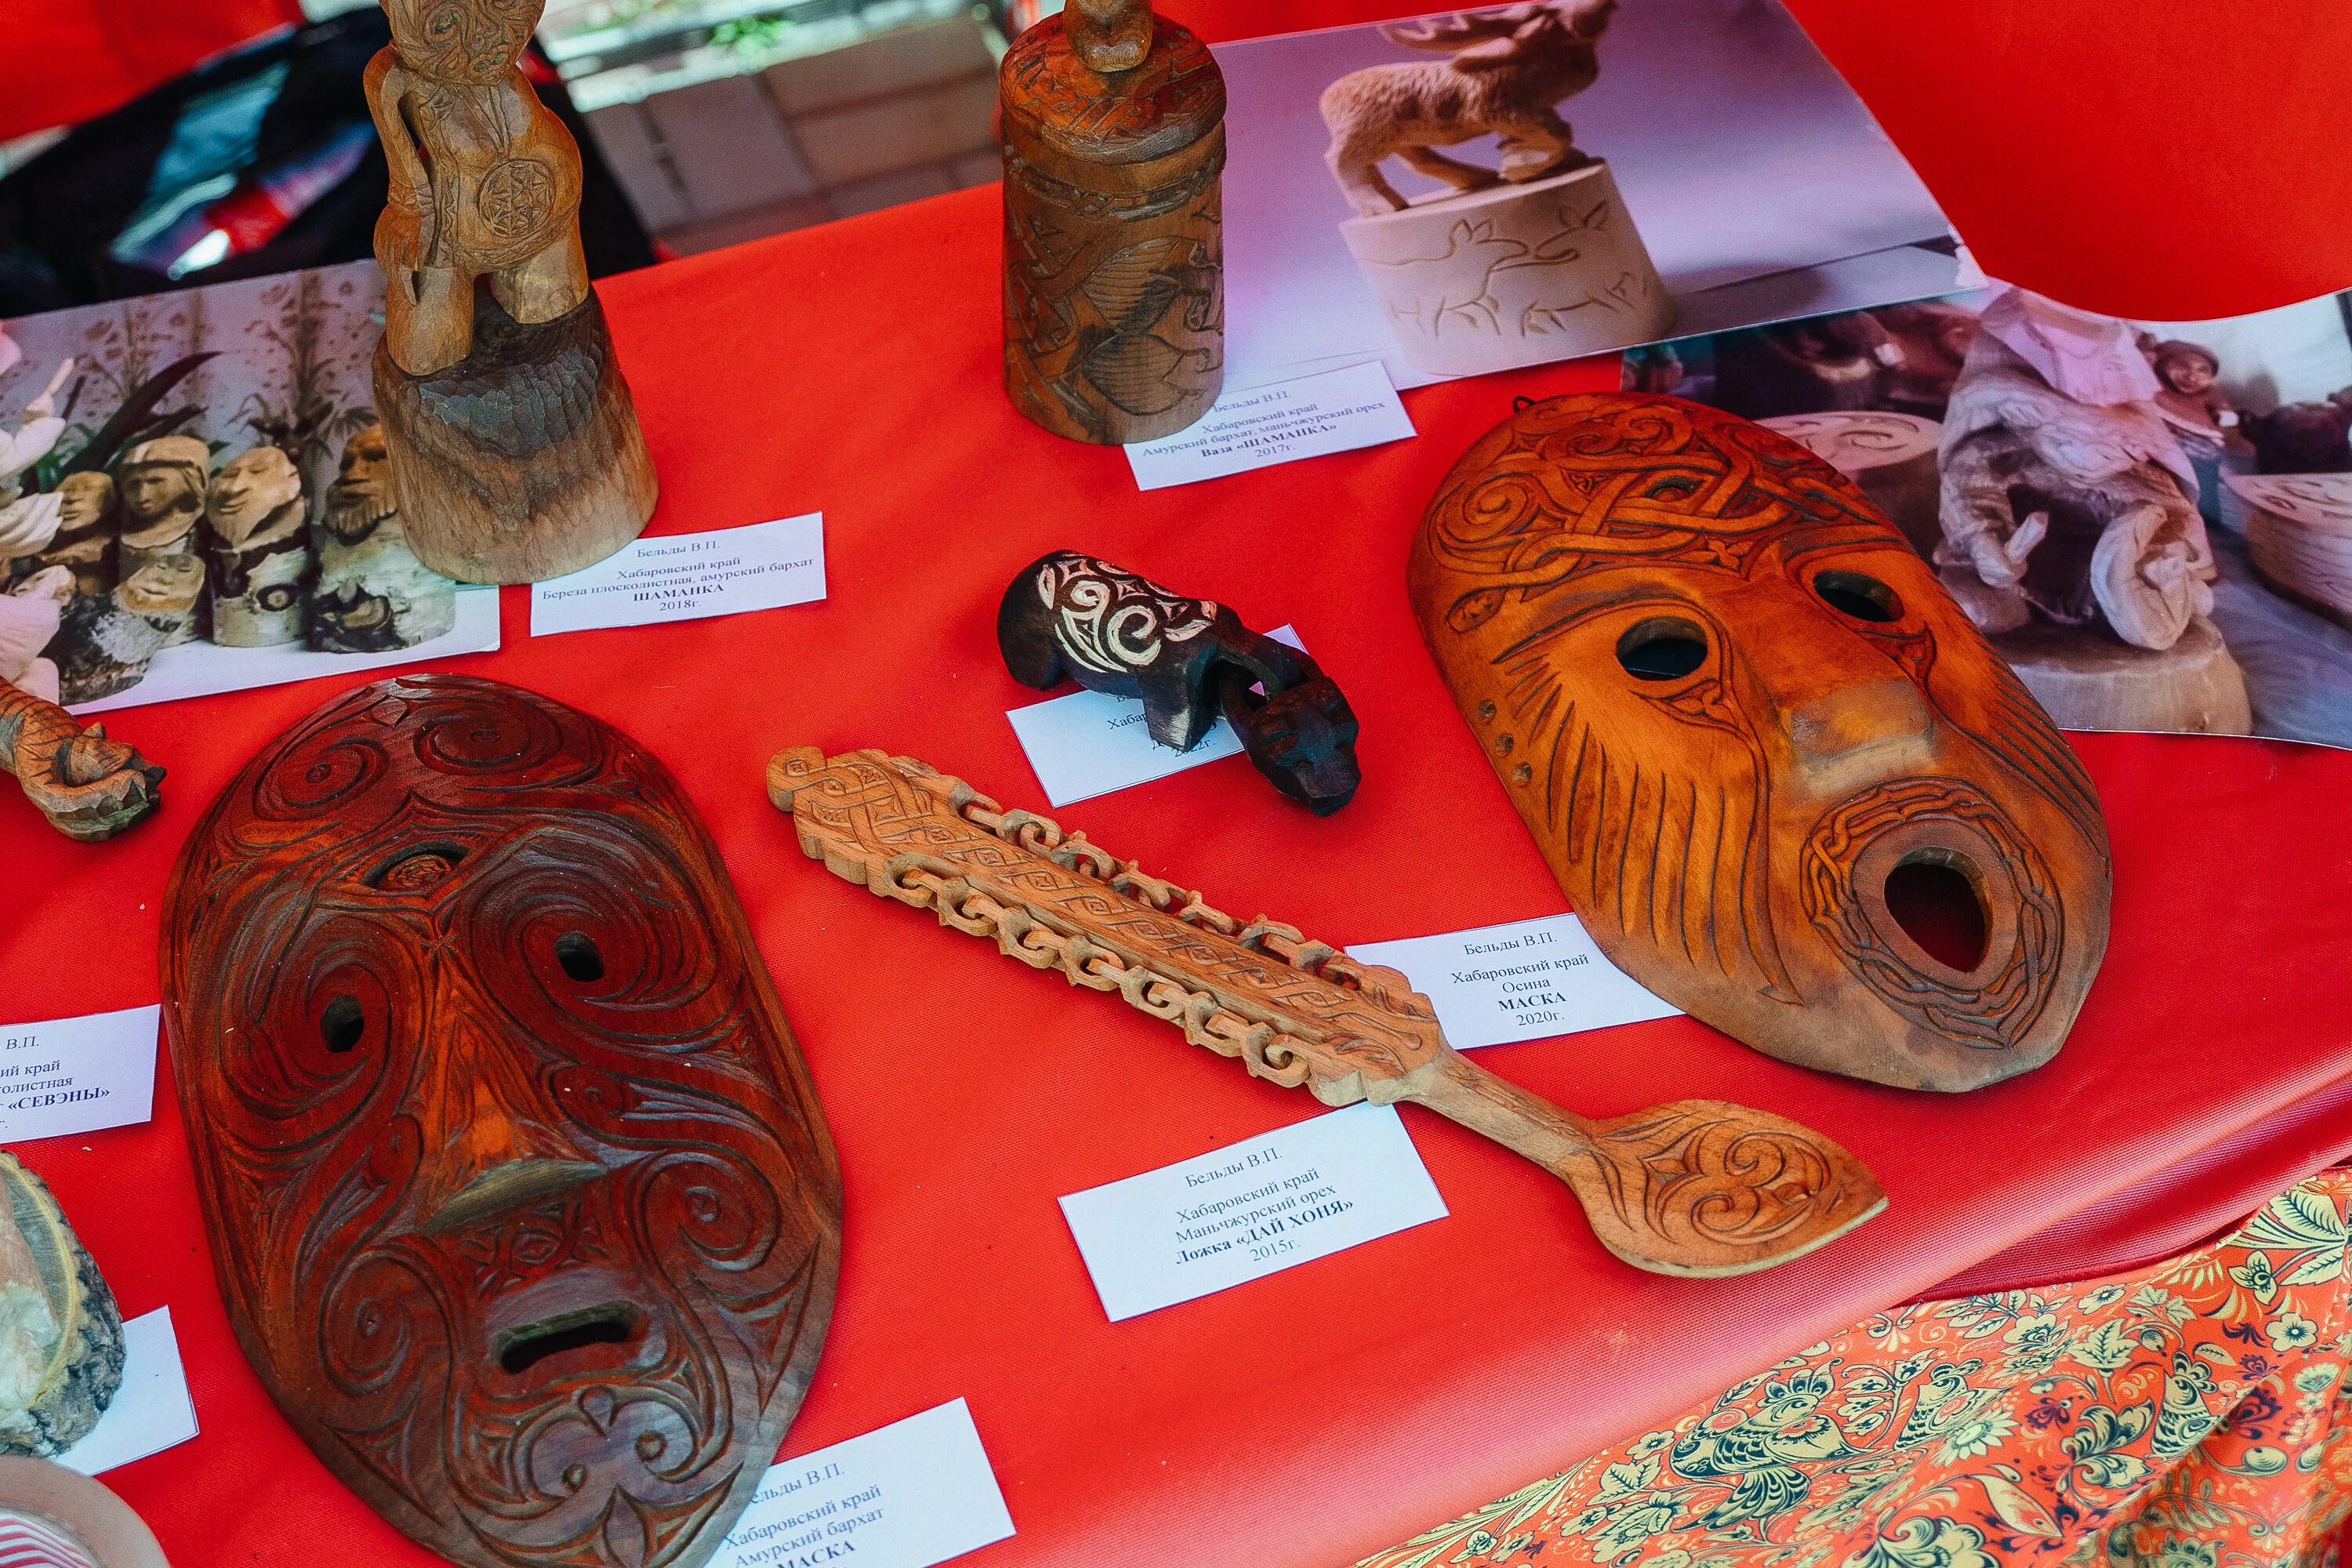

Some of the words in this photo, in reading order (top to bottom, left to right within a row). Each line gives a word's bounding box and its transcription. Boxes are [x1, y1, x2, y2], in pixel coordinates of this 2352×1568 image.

[1214, 398, 1260, 412] Бельды
[1263, 390, 1291, 402] В.П.
[1142, 438, 1208, 457] Амурский
[1258, 408, 1354, 434] маньчжурский
[1356, 401, 1385, 416] орех
[1202, 411, 1286, 434] Хабаровский
[1289, 403, 1318, 416] край
[1201, 445, 1233, 457] Ваза
[1236, 424, 1337, 450] «ШАМАНКА»
[1254, 444, 1296, 458] 2017г.
[637, 544, 687, 558] Бельды
[691, 539, 720, 552] В.П.
[543, 587, 587, 600] Береза
[591, 575, 696, 593] плосколистная,
[700, 565, 765, 585] амурский
[769, 557, 815, 574] бархат
[617, 562, 706, 580] Хабаровский
[710, 557, 741, 572] край
[633, 583, 724, 601] ШАМАНКА
[659, 599, 702, 612] 2018г.
[1464, 939, 1521, 956] Бельды
[1523, 931, 1558, 946] В.П.
[1450, 960, 1551, 984] Хабаровский
[1554, 953, 1589, 971] край
[1502, 977, 1551, 993] Осина
[1498, 991, 1567, 1011] МАСКА
[1516, 1011, 1565, 1026] 2020г.
[6, 1036, 39, 1050] В.П.
[24, 1060, 61, 1076] край
[0, 1077, 74, 1094] олистная
[8, 1087, 111, 1110] «СЕВЭНЫ»
[1185, 1162, 1244, 1189] Бельды
[1246, 1147, 1283, 1168] В.П.
[1176, 1181, 1279, 1224] Хабаровский
[1283, 1167, 1320, 1191] край
[1175, 1195, 1297, 1243] Маньчжурский
[1300, 1185, 1337, 1208] орех
[1175, 1240, 1232, 1265] Ложка
[1236, 1220, 1287, 1247] «ДАЙ
[1290, 1200, 1354, 1230] ХОНЯ»
[1250, 1238, 1301, 1262] 2015г.
[750, 1480, 802, 1504] ельды
[806, 1462, 846, 1486] В.П.
[724, 1501, 837, 1549] Хабаровский
[842, 1484, 881, 1509] край
[736, 1528, 822, 1568] Амурский
[827, 1508, 884, 1536] бархат
